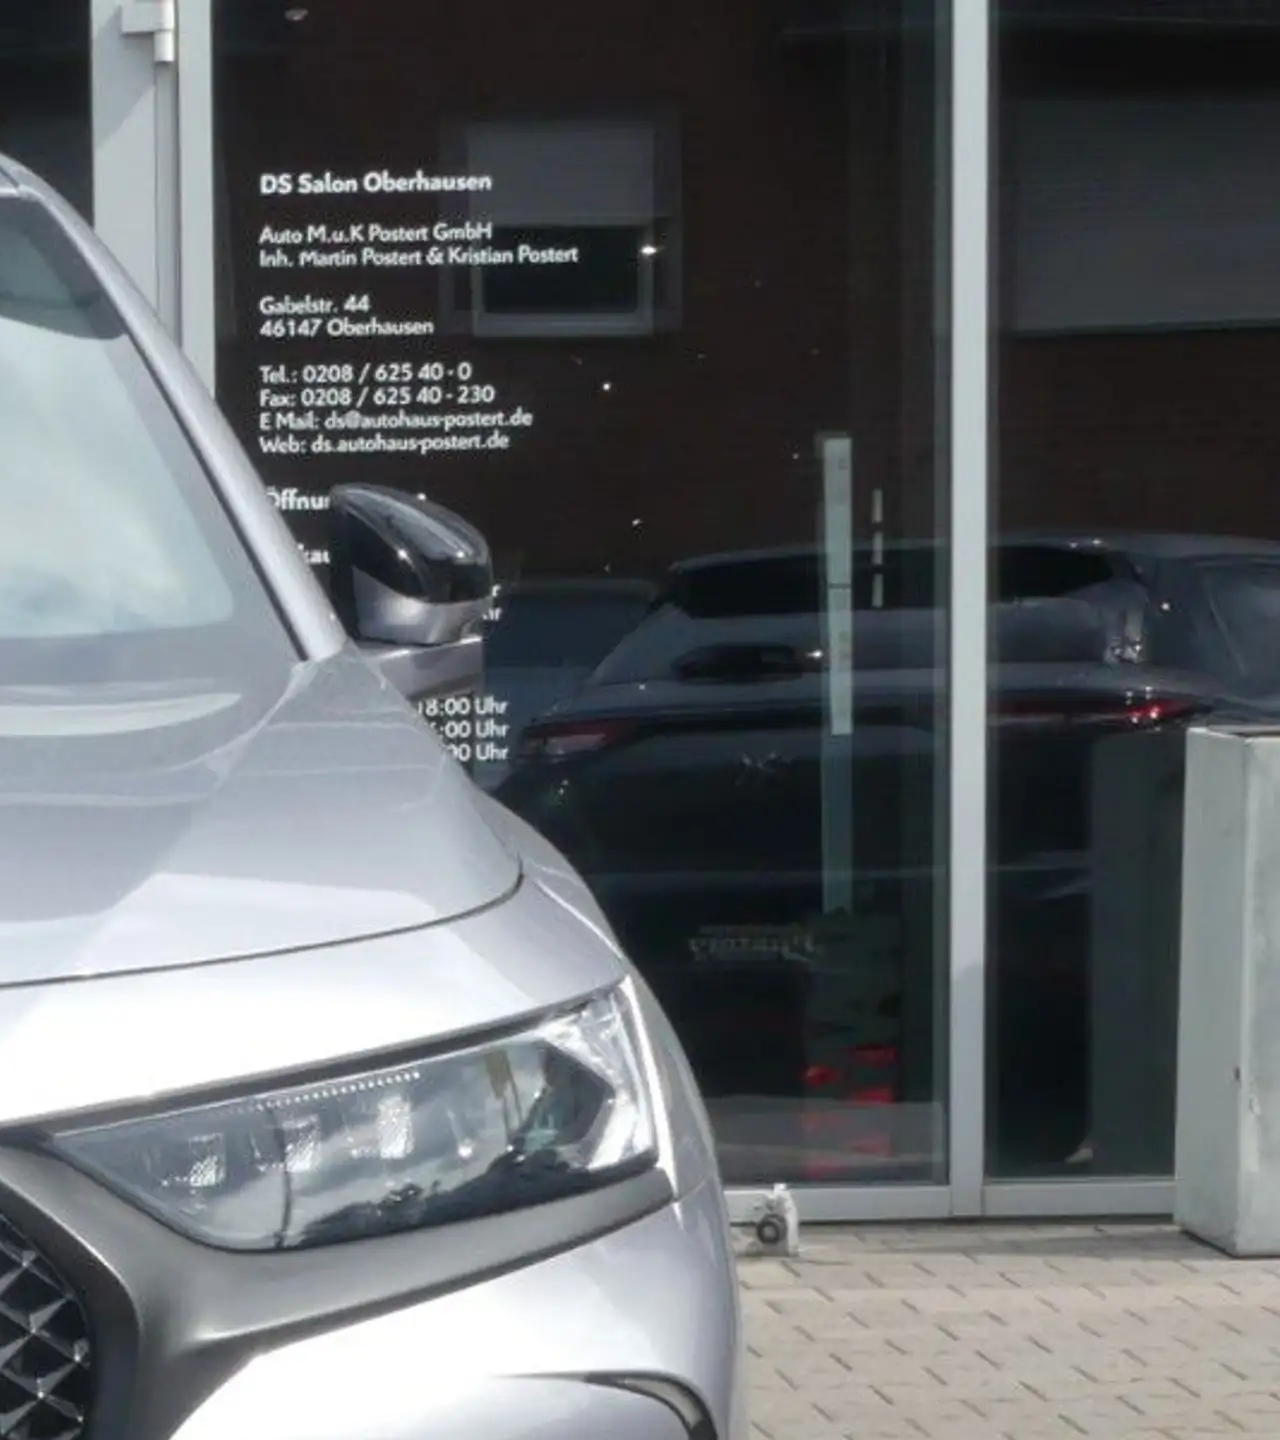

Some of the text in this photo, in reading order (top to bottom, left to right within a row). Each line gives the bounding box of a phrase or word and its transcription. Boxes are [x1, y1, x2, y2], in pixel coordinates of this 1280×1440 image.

[260, 169, 492, 195] DS Salon Oberhausen
[258, 221, 492, 244] Auto M.u.K Postert GmbH
[260, 244, 578, 267] Inh. Martin Postert & Kristian Postert
[259, 294, 370, 315] Gabelstr. 44
[260, 316, 434, 337] 46147 Oberhausen
[259, 364, 297, 384] Tel.:
[302, 364, 353, 383] 0208
[358, 363, 371, 385] /
[374, 362, 413, 382] 625
[418, 362, 448, 381] 40
[457, 362, 472, 381] 0
[260, 388, 296, 407] Fax:
[301, 387, 352, 407] 0208
[356, 384, 369, 408] /
[373, 386, 412, 406] 625
[416, 386, 442, 404] 40
[457, 384, 496, 404] 230
[260, 405, 533, 431] E Mail: ds@autohaus-postert.de
[258, 429, 510, 455] Web: ds.autohaus-postert.de
[475, 695, 509, 715] Uhr
[475, 718, 510, 738] Uhr
[475, 741, 509, 761] Uhr
